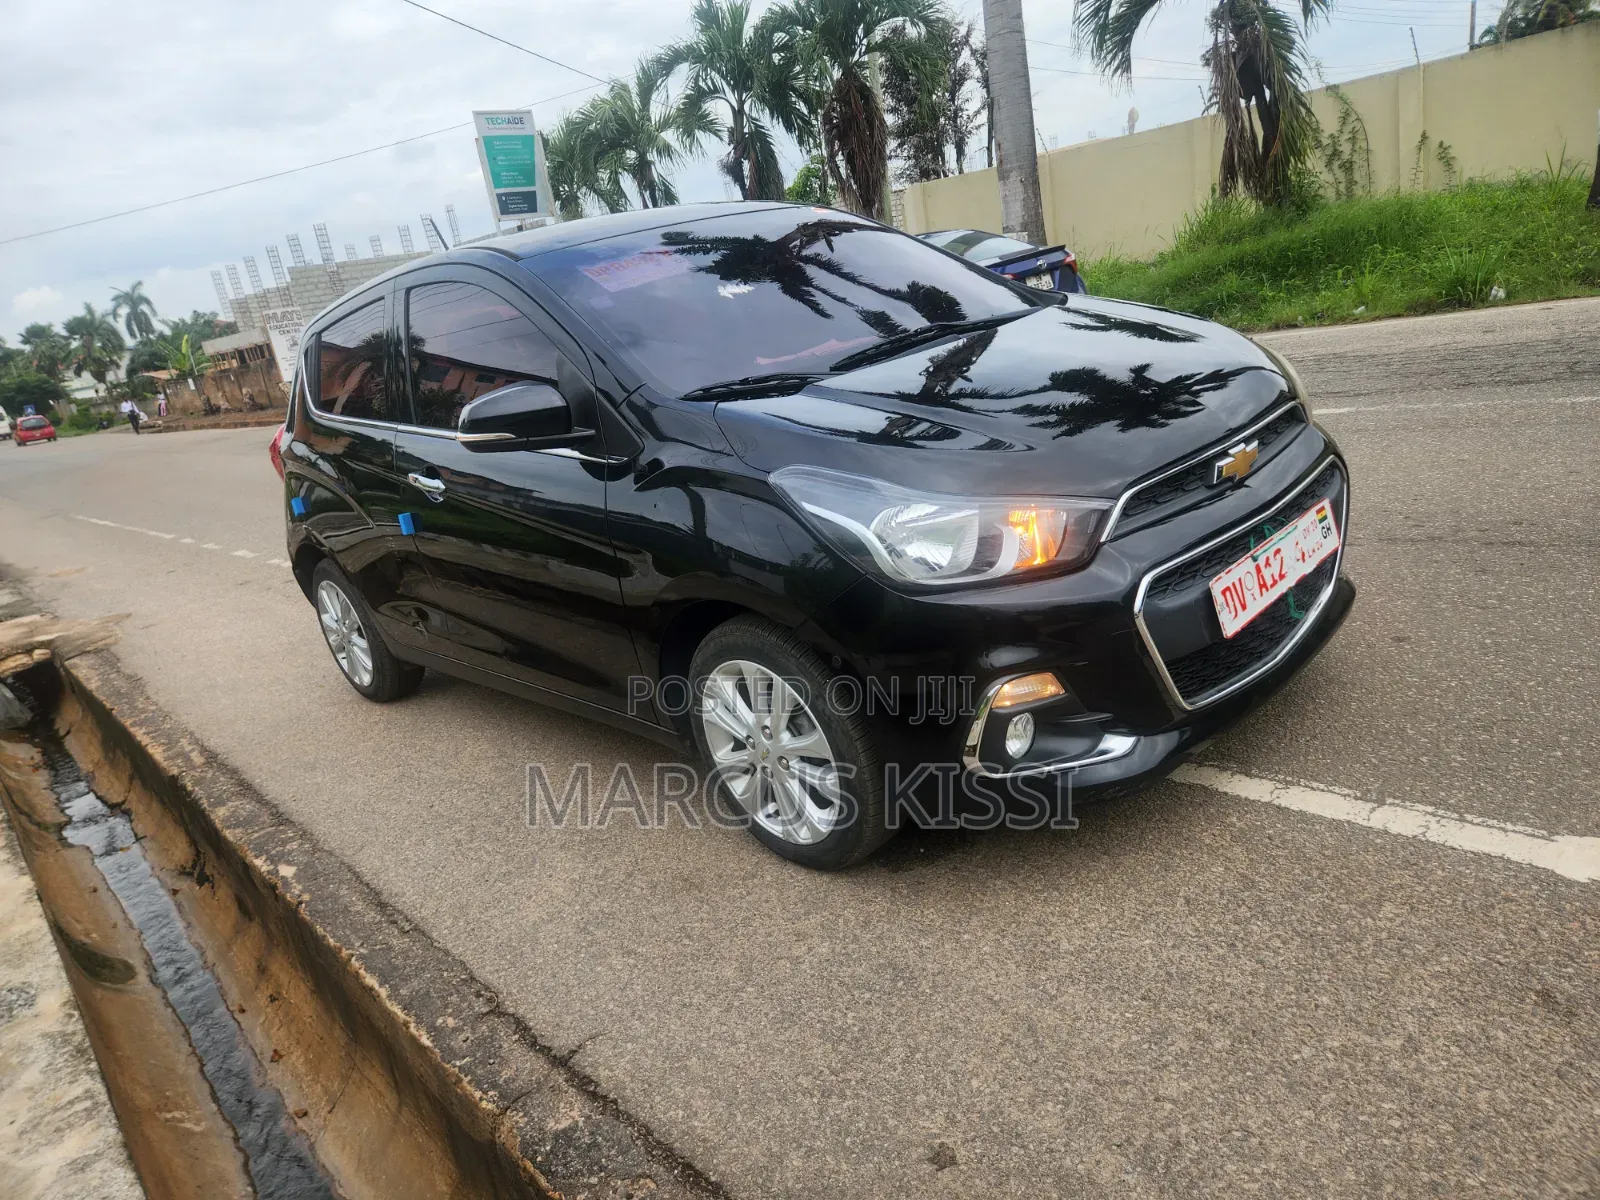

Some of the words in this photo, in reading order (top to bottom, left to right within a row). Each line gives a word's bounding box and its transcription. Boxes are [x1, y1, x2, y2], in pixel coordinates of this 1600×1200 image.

[265, 310, 303, 324] MAYS
[279, 328, 301, 336] CENTRE
[1321, 522, 1333, 539] GH
